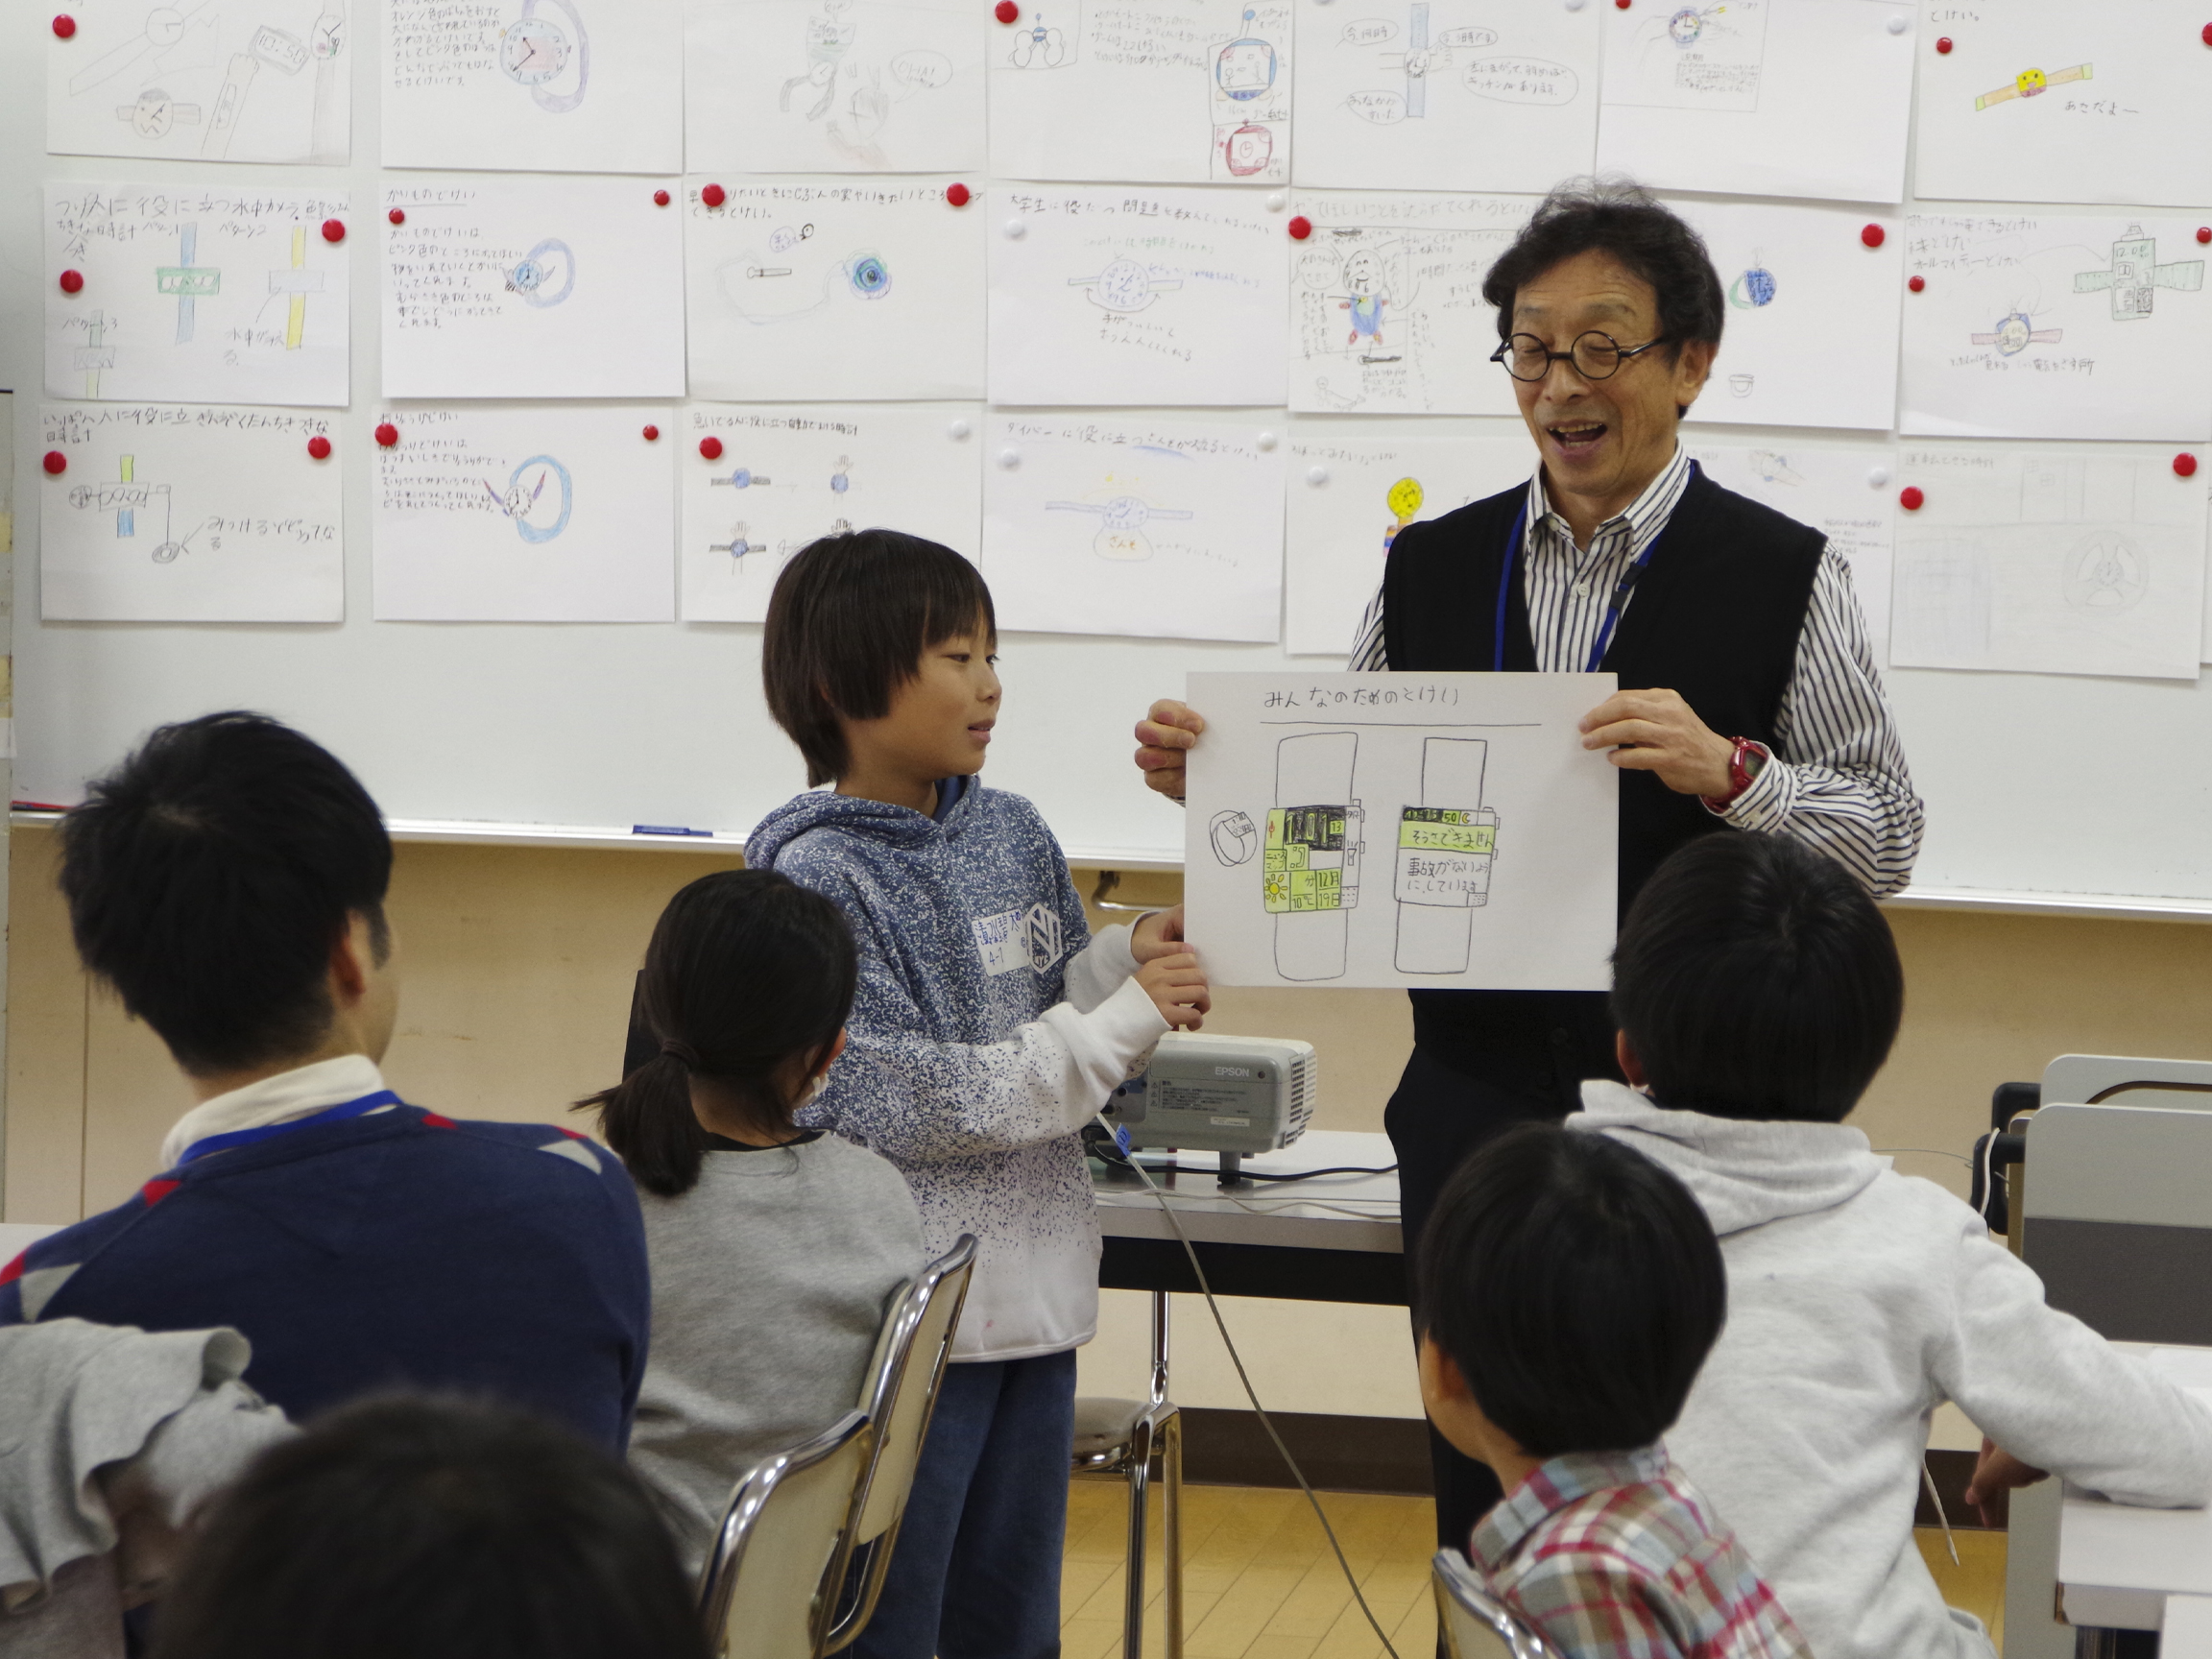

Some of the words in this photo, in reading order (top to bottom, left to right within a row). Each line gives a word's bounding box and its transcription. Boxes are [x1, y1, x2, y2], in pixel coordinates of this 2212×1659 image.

[1263, 686, 1460, 709] みんなのためのとけい
[1412, 828, 1494, 849] そうさできません
[1407, 857, 1490, 878] 事故がないよう
[1318, 871, 1339, 888] 12月
[1319, 893, 1341, 907] 19日
[1214, 1067, 1250, 1077] EPSON
